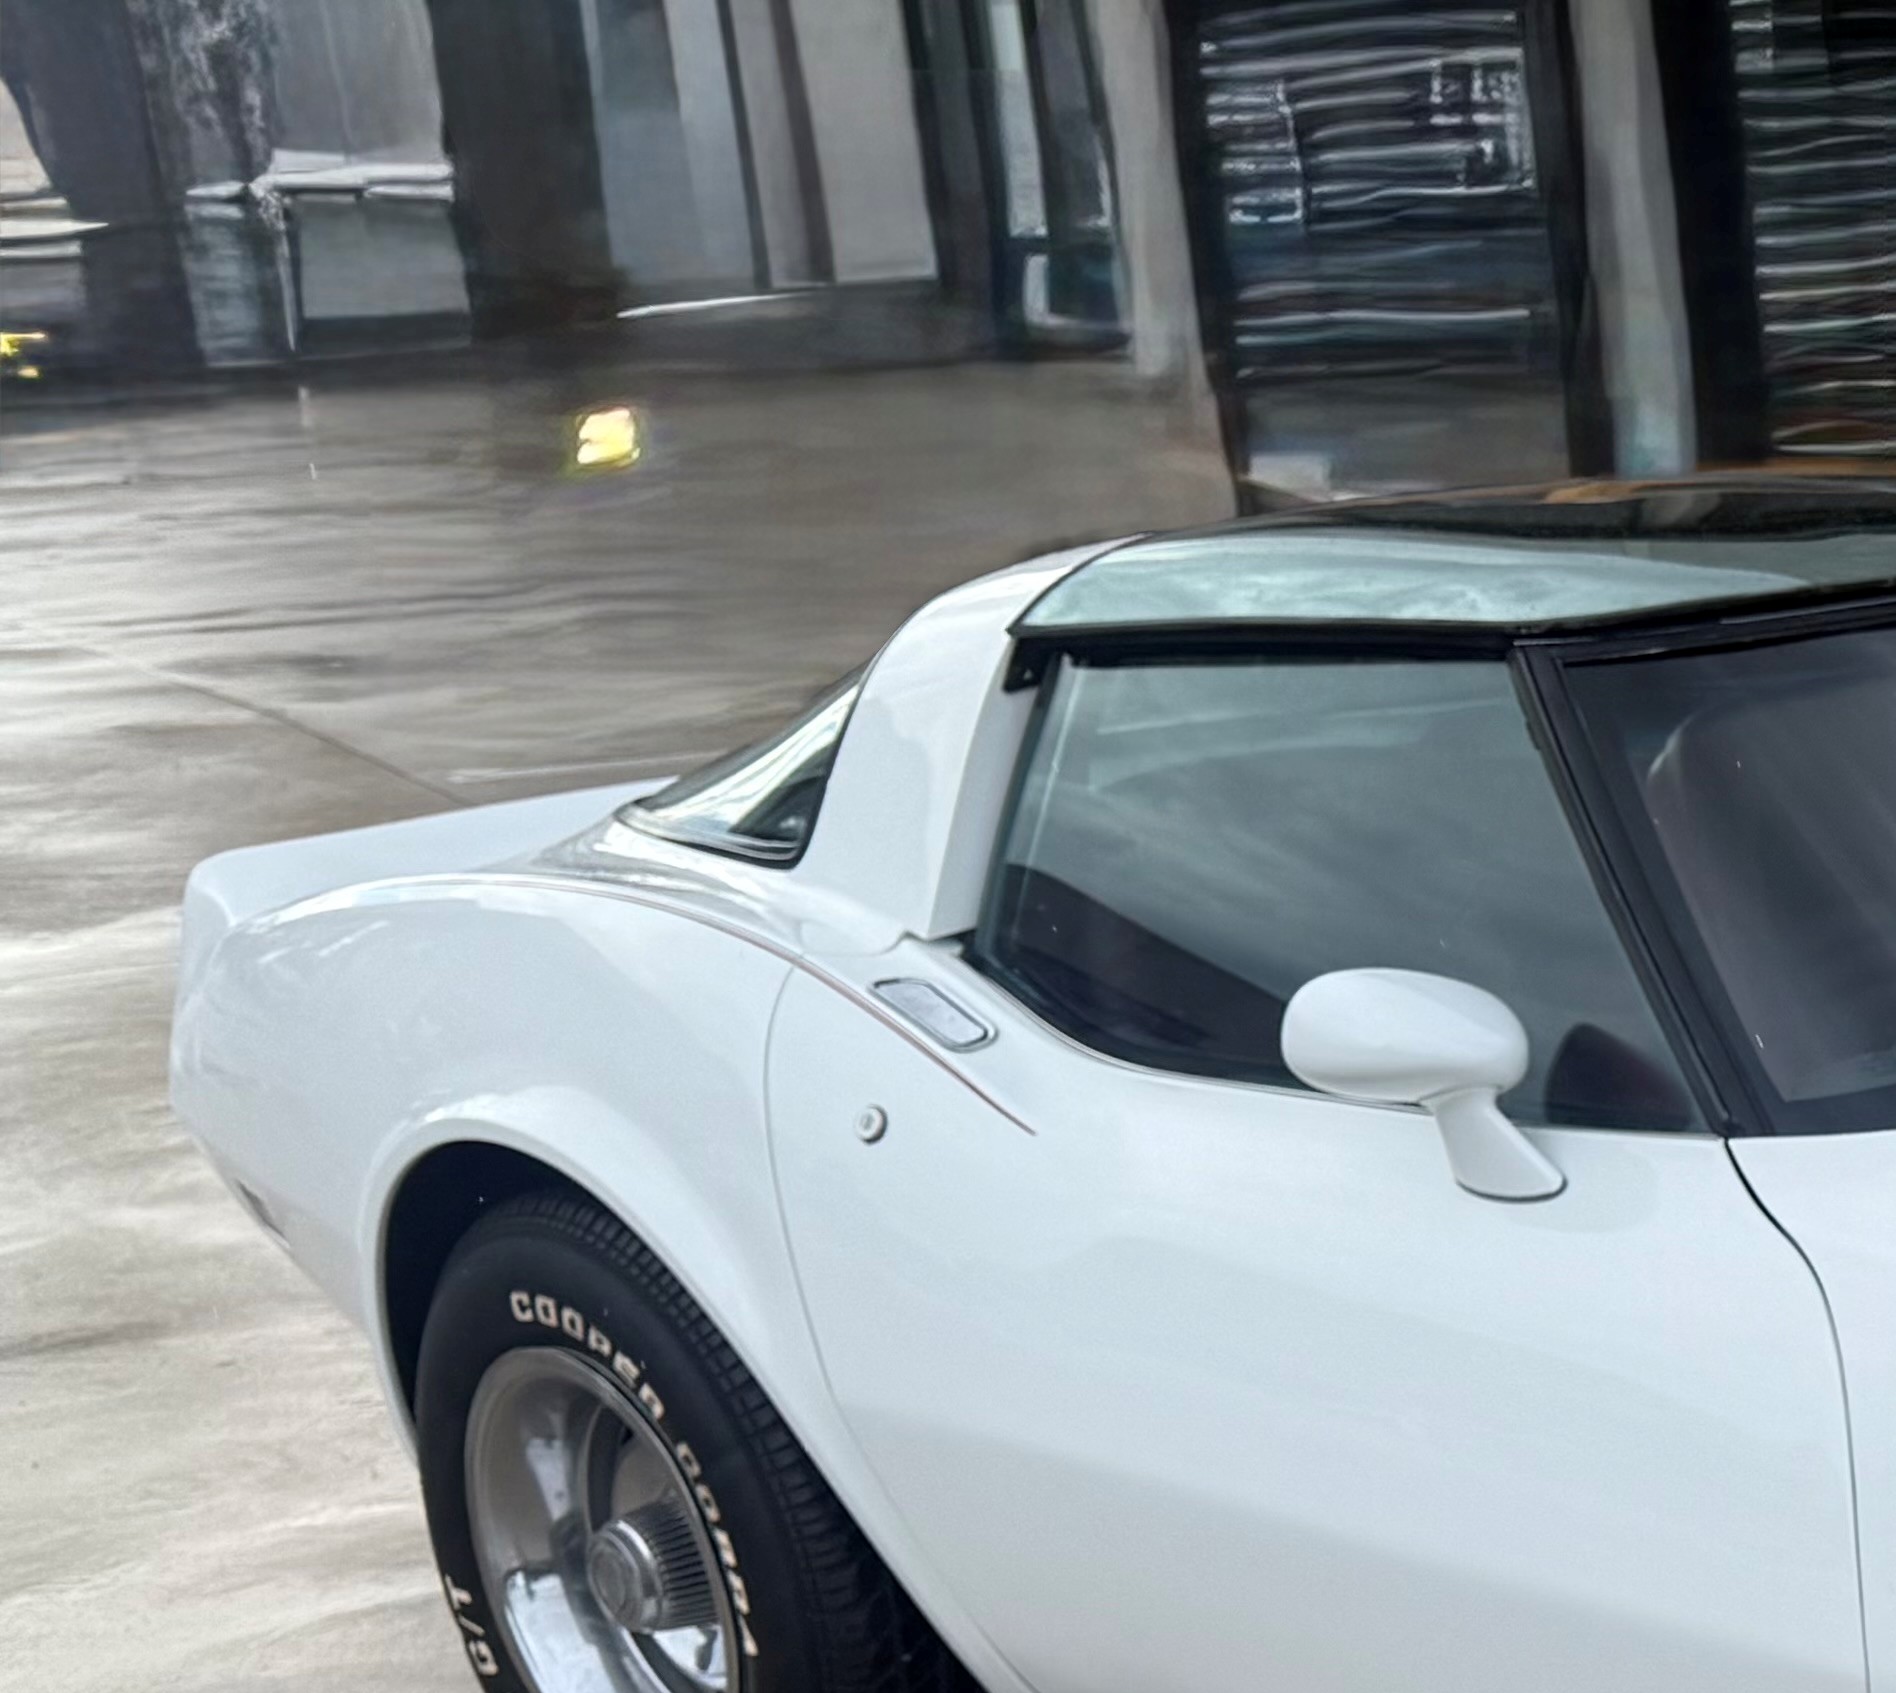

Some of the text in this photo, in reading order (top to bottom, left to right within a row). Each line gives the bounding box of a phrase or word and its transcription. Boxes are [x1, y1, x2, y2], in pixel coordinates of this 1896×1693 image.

[510, 1292, 758, 1656] COOPER COBRA
[444, 1574, 497, 1674] G/T
